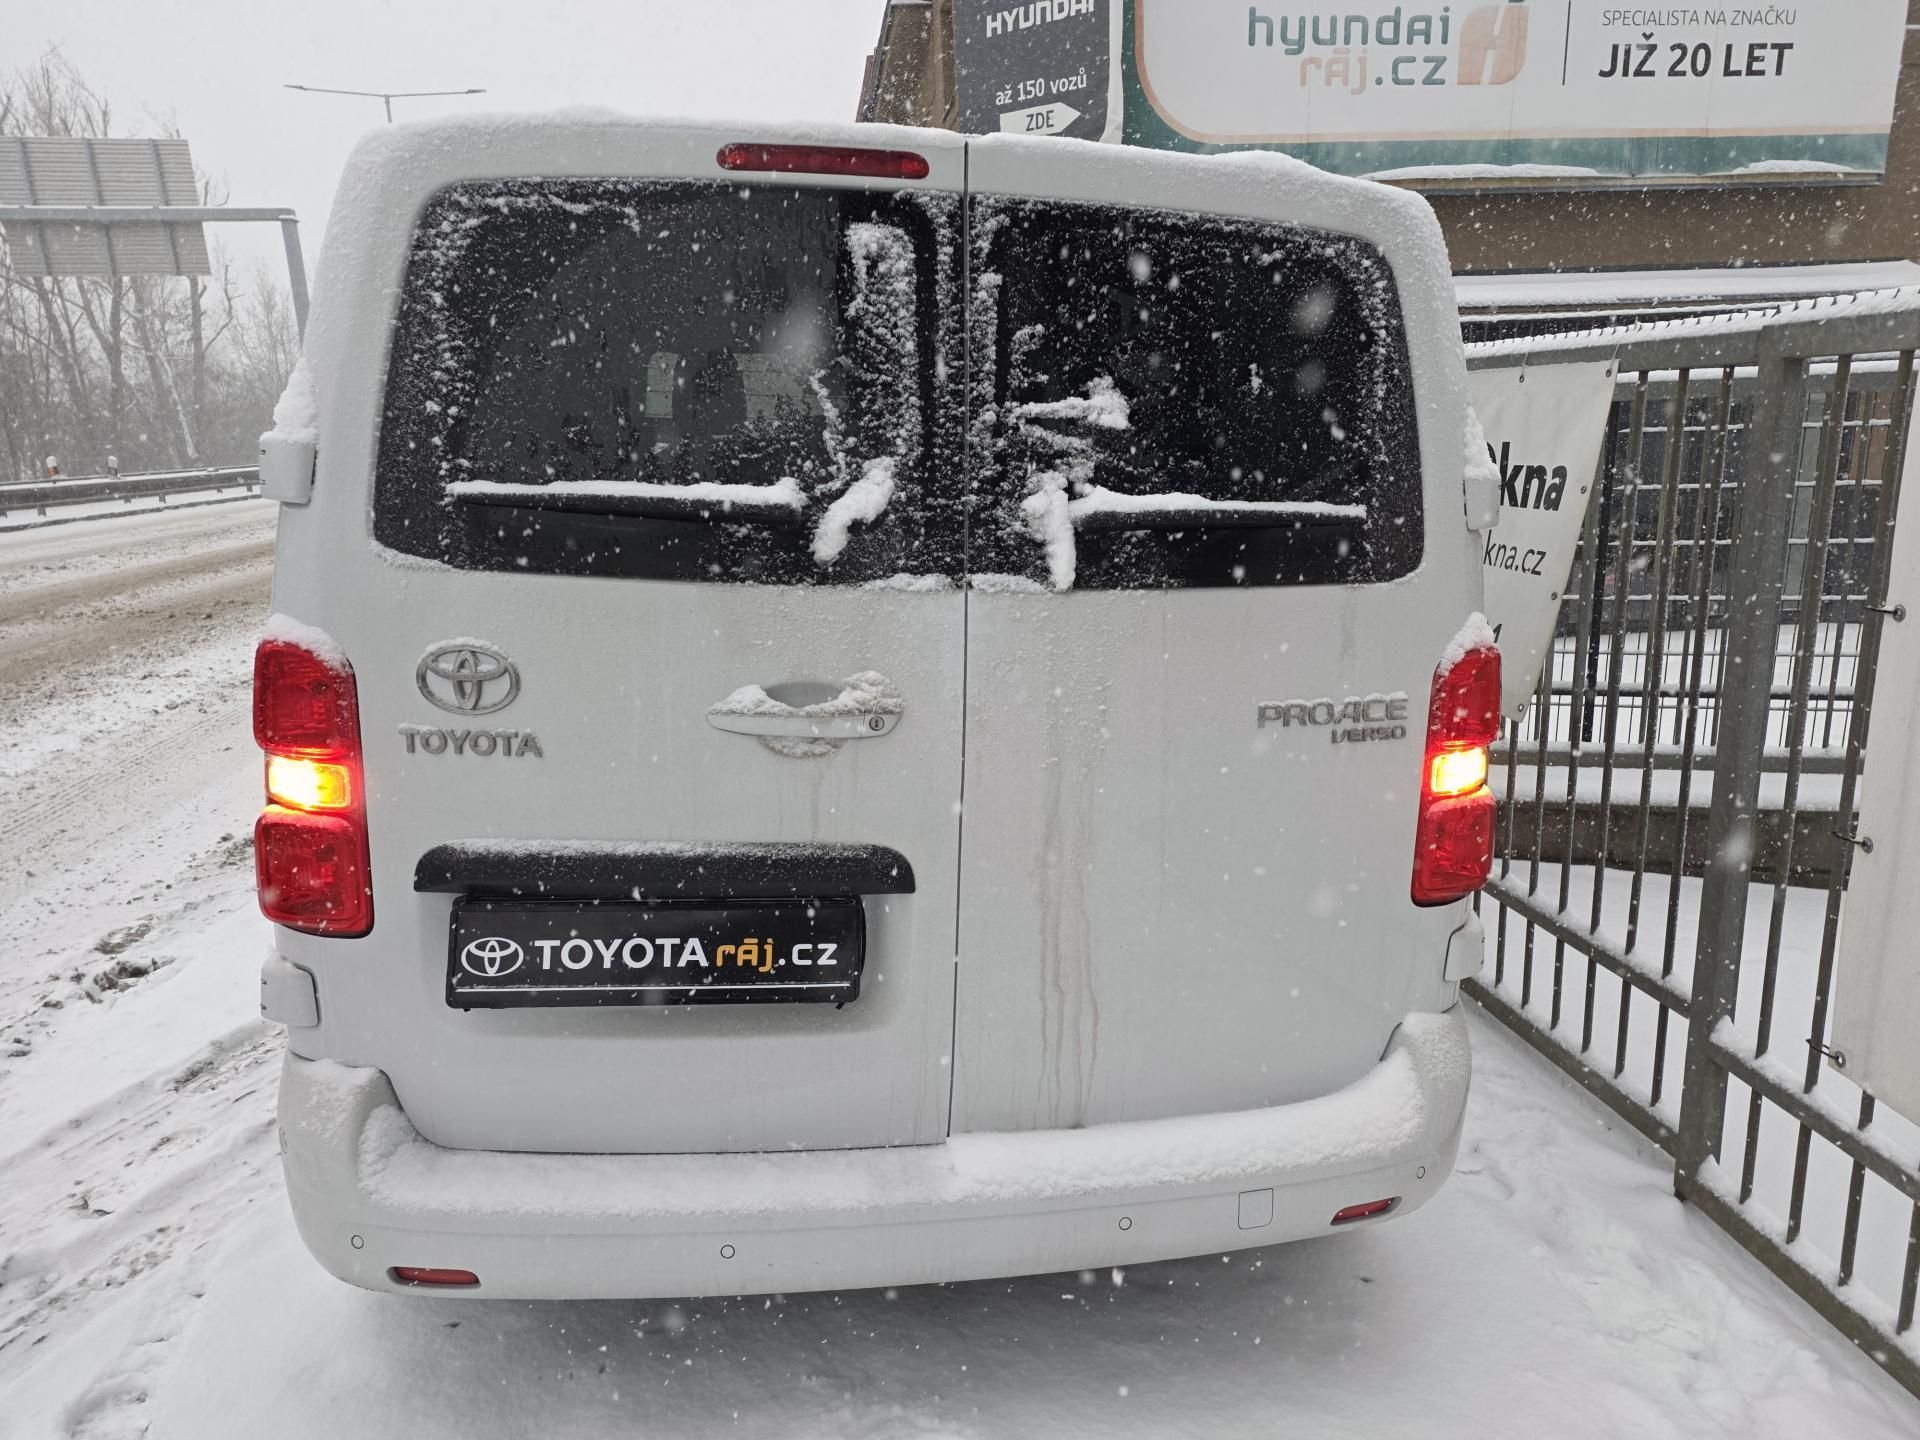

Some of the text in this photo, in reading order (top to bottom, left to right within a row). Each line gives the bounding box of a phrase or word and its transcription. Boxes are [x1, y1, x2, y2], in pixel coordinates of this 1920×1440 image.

[1602, 5, 1798, 26] SPECIALISTA NA ZNAČKU
[1598, 31, 1795, 78] JIŽ 20 LET
[995, 66, 1088, 106] až 150 vozů
[1025, 109, 1055, 132] ZDE
[1486, 441, 1568, 512] kna
[1257, 697, 1409, 729] PROACE
[398, 725, 544, 758] TOYOTA
[1331, 724, 1407, 744] VERSO
